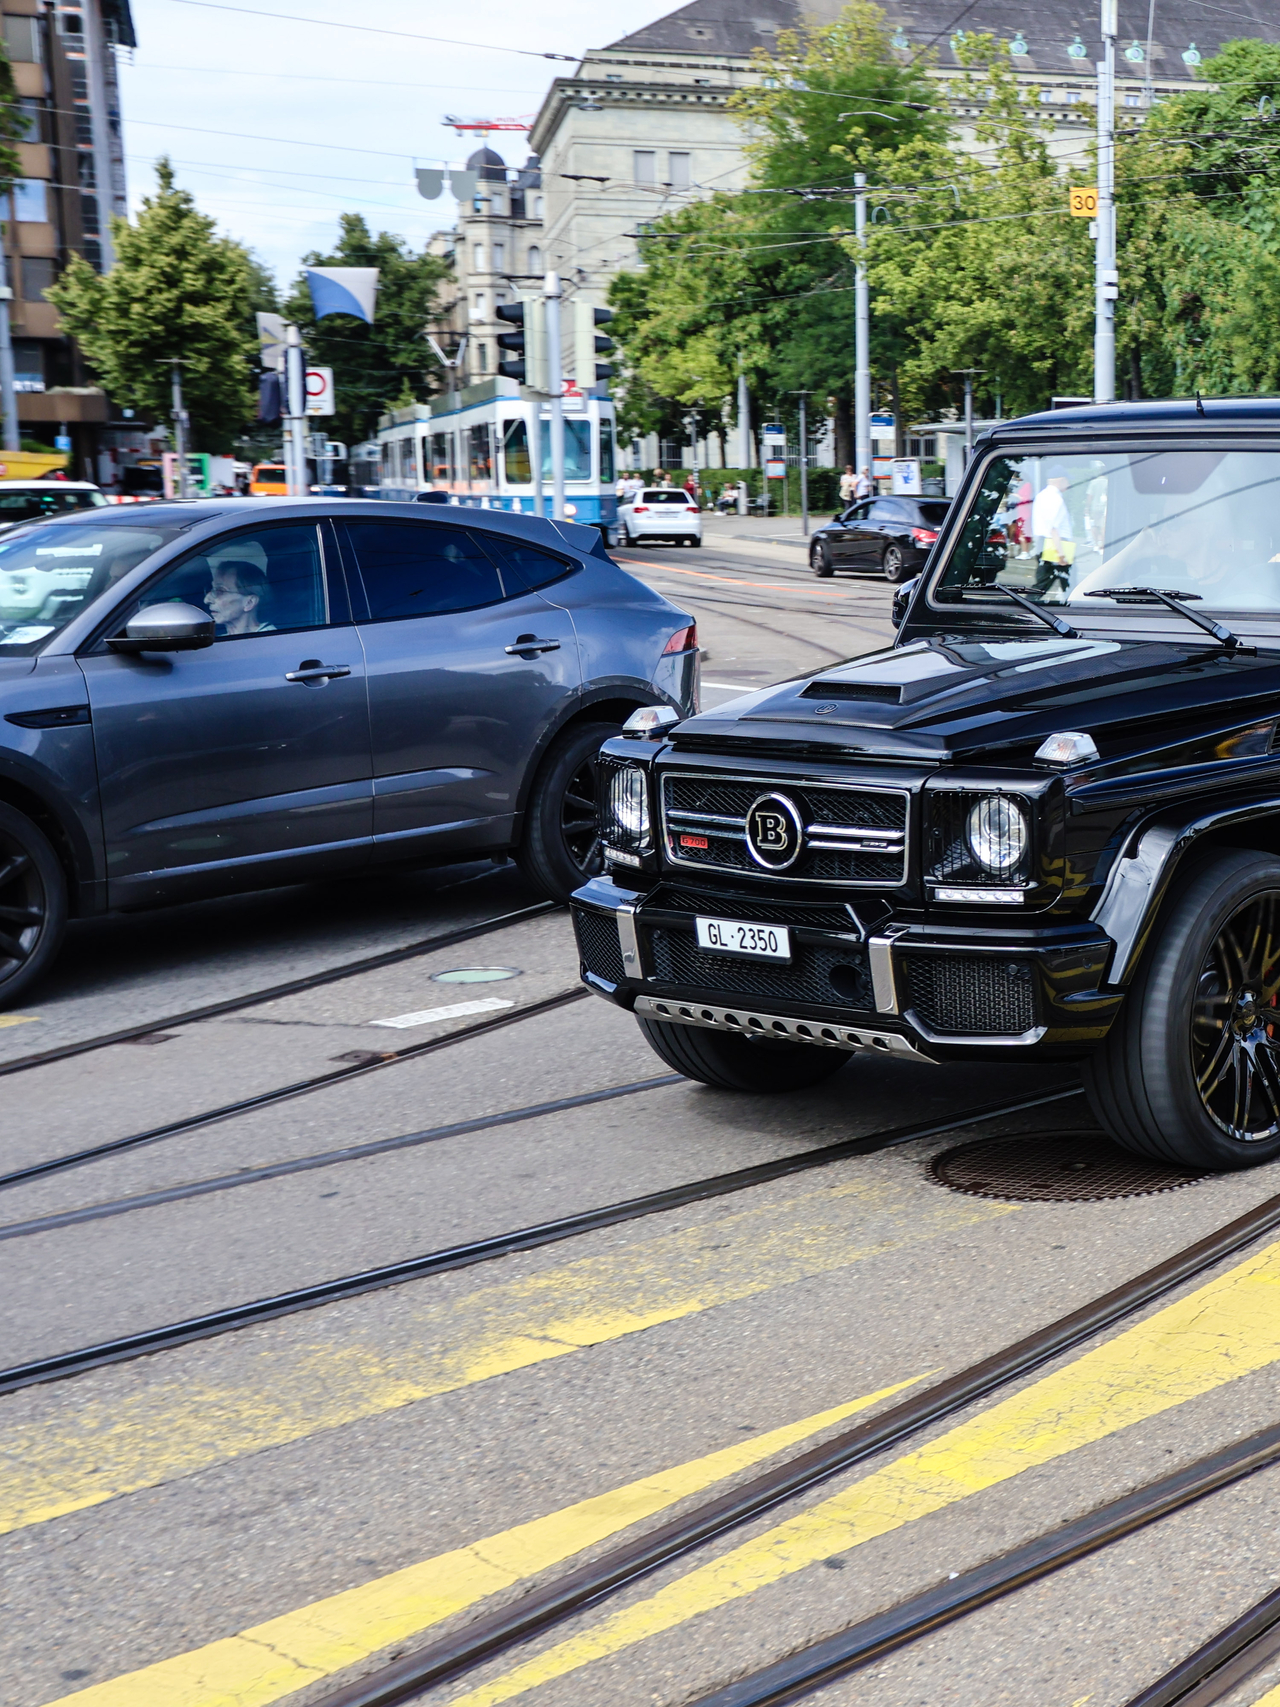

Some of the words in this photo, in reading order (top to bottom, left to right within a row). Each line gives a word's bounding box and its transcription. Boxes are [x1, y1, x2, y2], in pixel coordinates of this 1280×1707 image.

[1073, 195, 1097, 210] 30
[756, 811, 788, 850] B
[690, 838, 706, 846] 700
